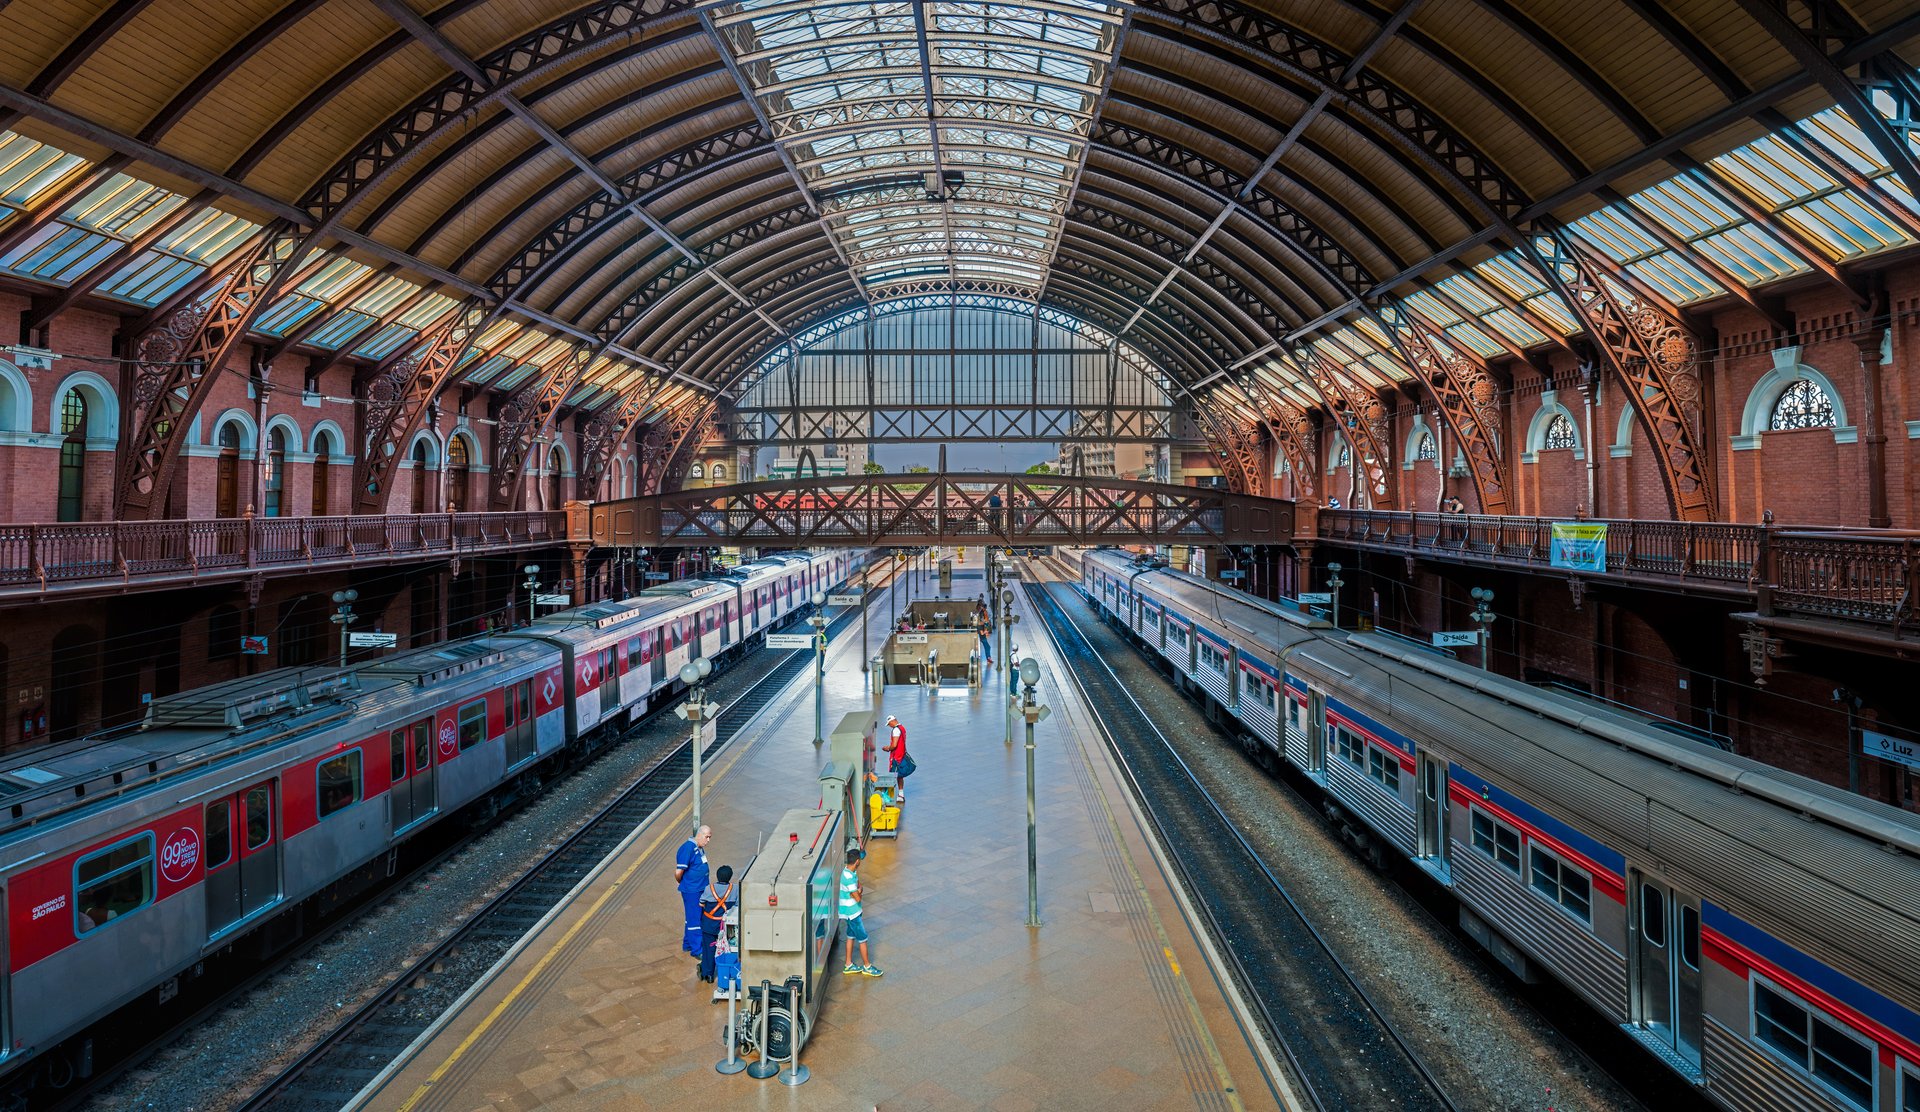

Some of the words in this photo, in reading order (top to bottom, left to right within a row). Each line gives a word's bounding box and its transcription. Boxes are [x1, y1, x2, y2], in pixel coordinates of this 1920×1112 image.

[1893, 741, 1913, 757] Luz
[181, 842, 197, 854] NOVO
[181, 849, 196, 860] TREM
[180, 856, 196, 868] CPTM
[32, 898, 58, 913] GOVERNO
[57, 894, 65, 903] DE
[45, 900, 66, 914] PAULO
